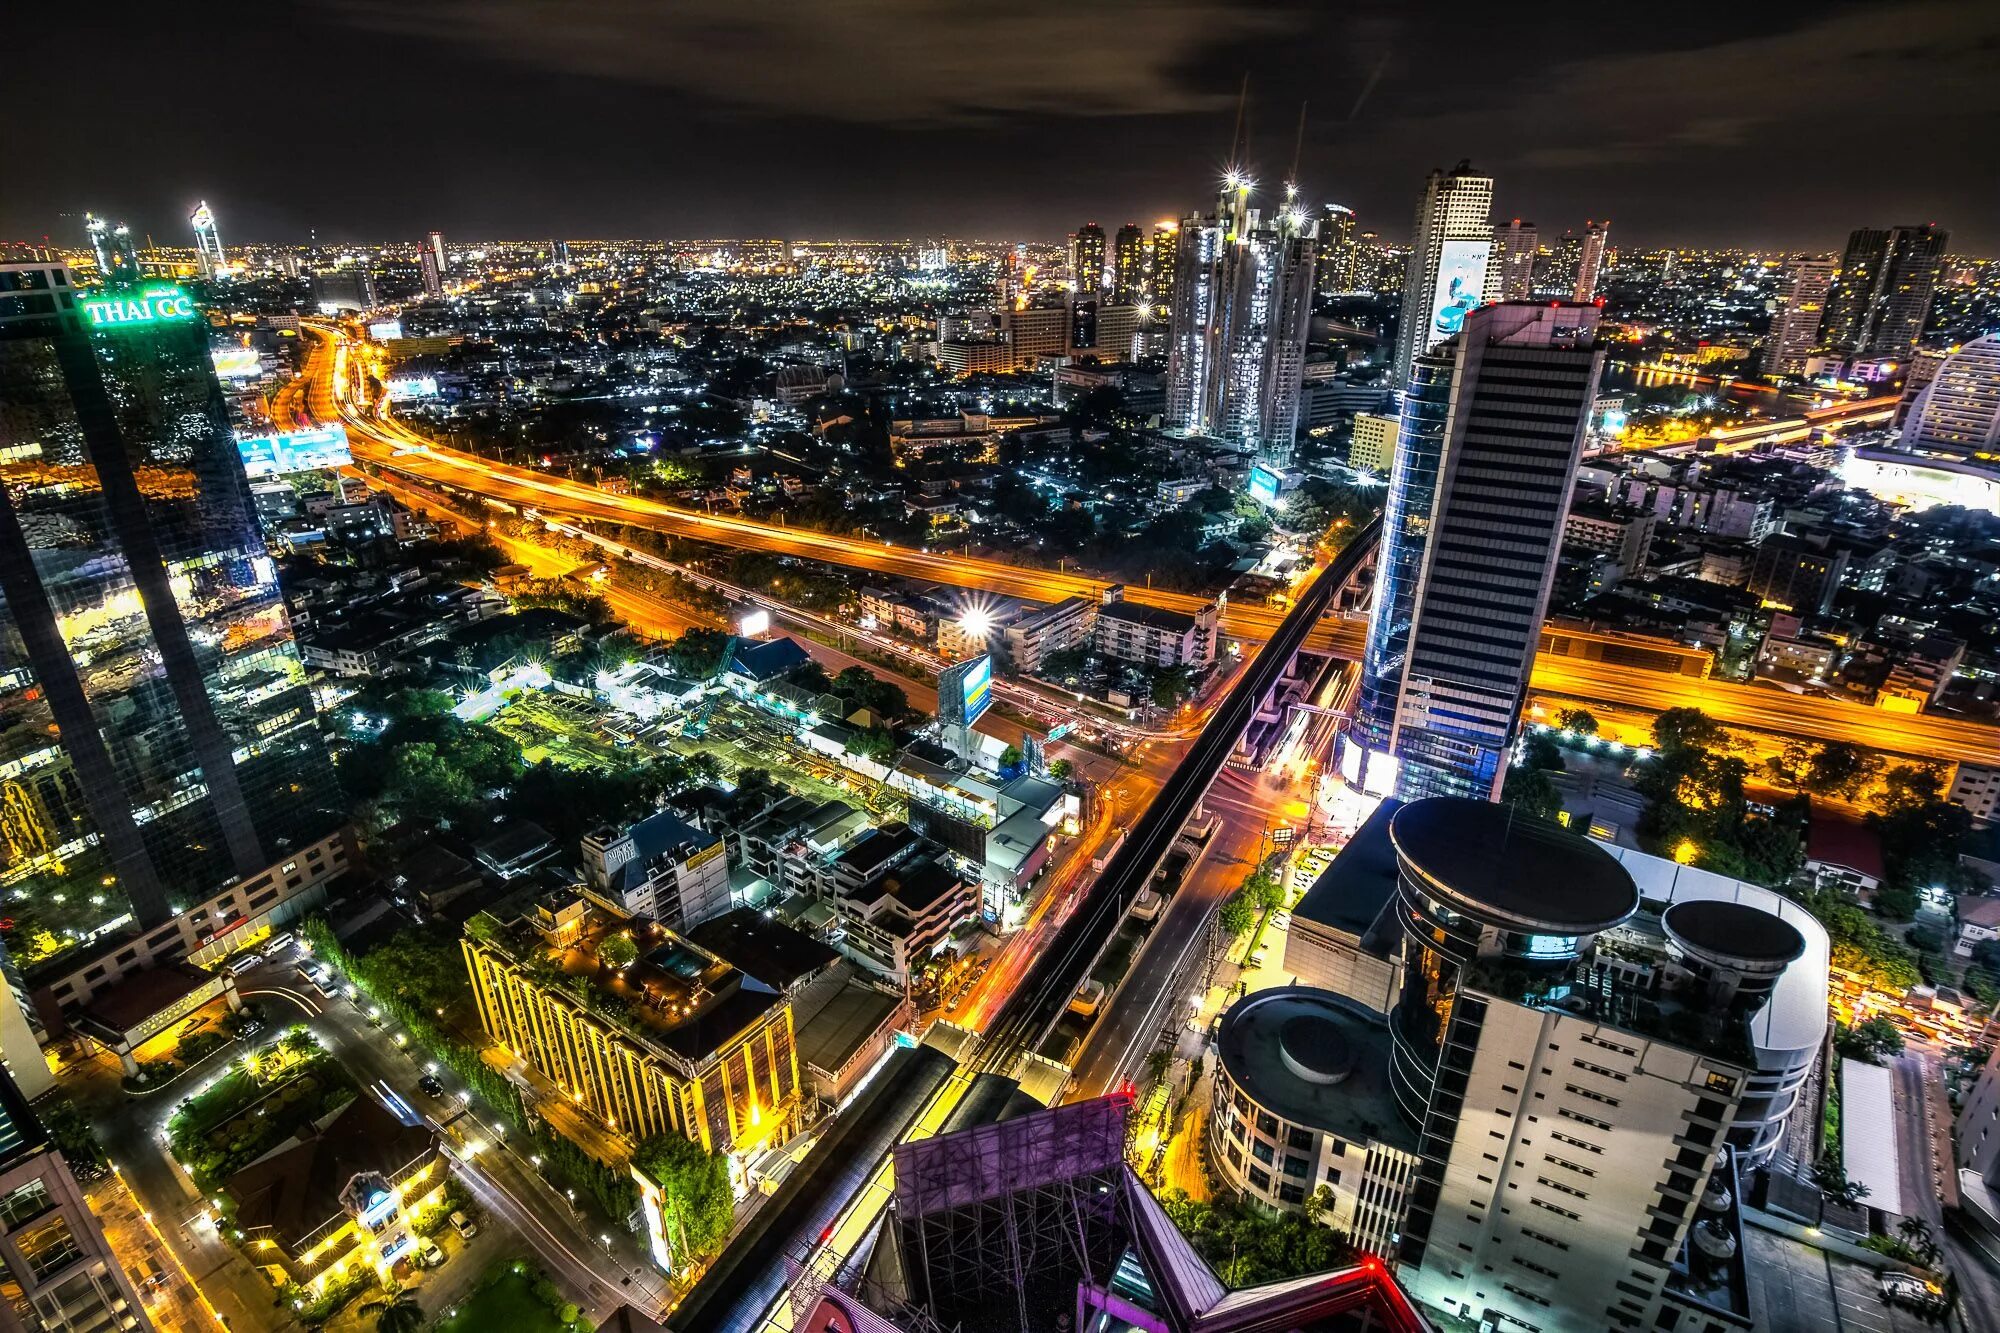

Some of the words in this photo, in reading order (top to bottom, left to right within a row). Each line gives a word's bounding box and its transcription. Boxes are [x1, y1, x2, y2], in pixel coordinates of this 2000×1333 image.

[85, 300, 154, 324] THAI
[157, 297, 193, 318] CC
[1305, 937, 1340, 955] HONDA
